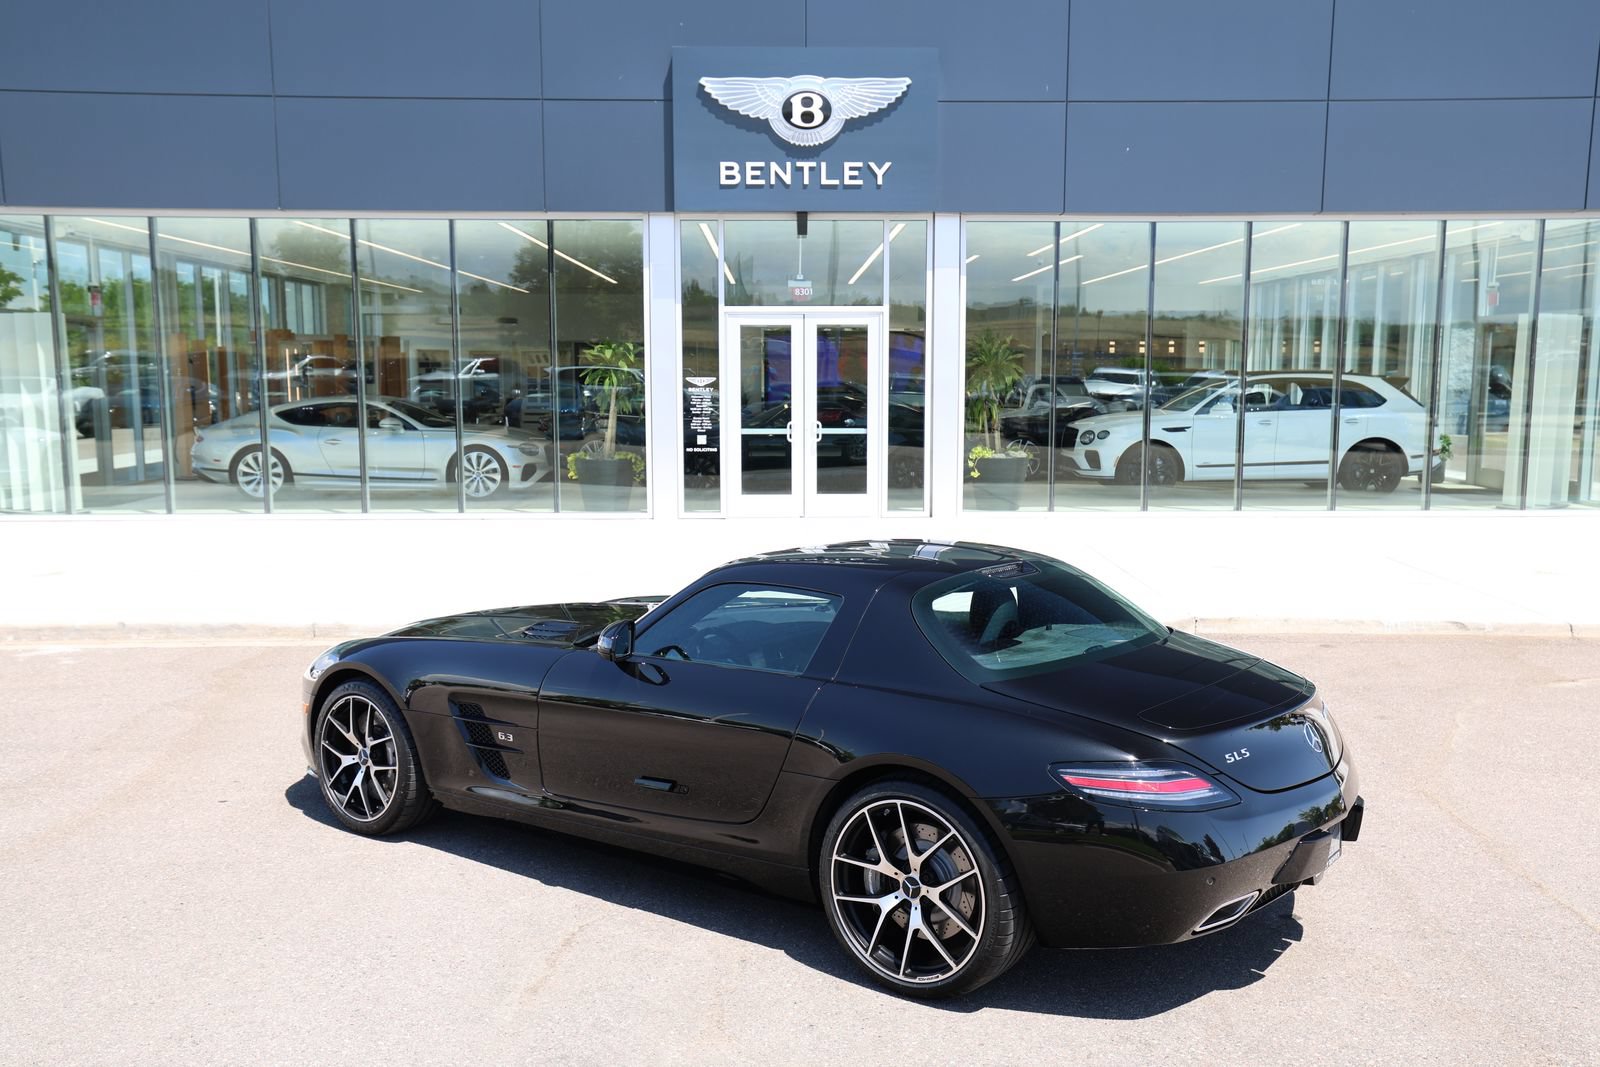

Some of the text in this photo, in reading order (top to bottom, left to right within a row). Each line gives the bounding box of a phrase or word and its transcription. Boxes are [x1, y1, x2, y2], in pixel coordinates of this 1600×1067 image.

[790, 92, 824, 127] B
[719, 161, 892, 185] BENTLEY
[794, 287, 813, 296] 8301
[498, 731, 513, 742] 6.3
[1225, 747, 1250, 763] SLS
